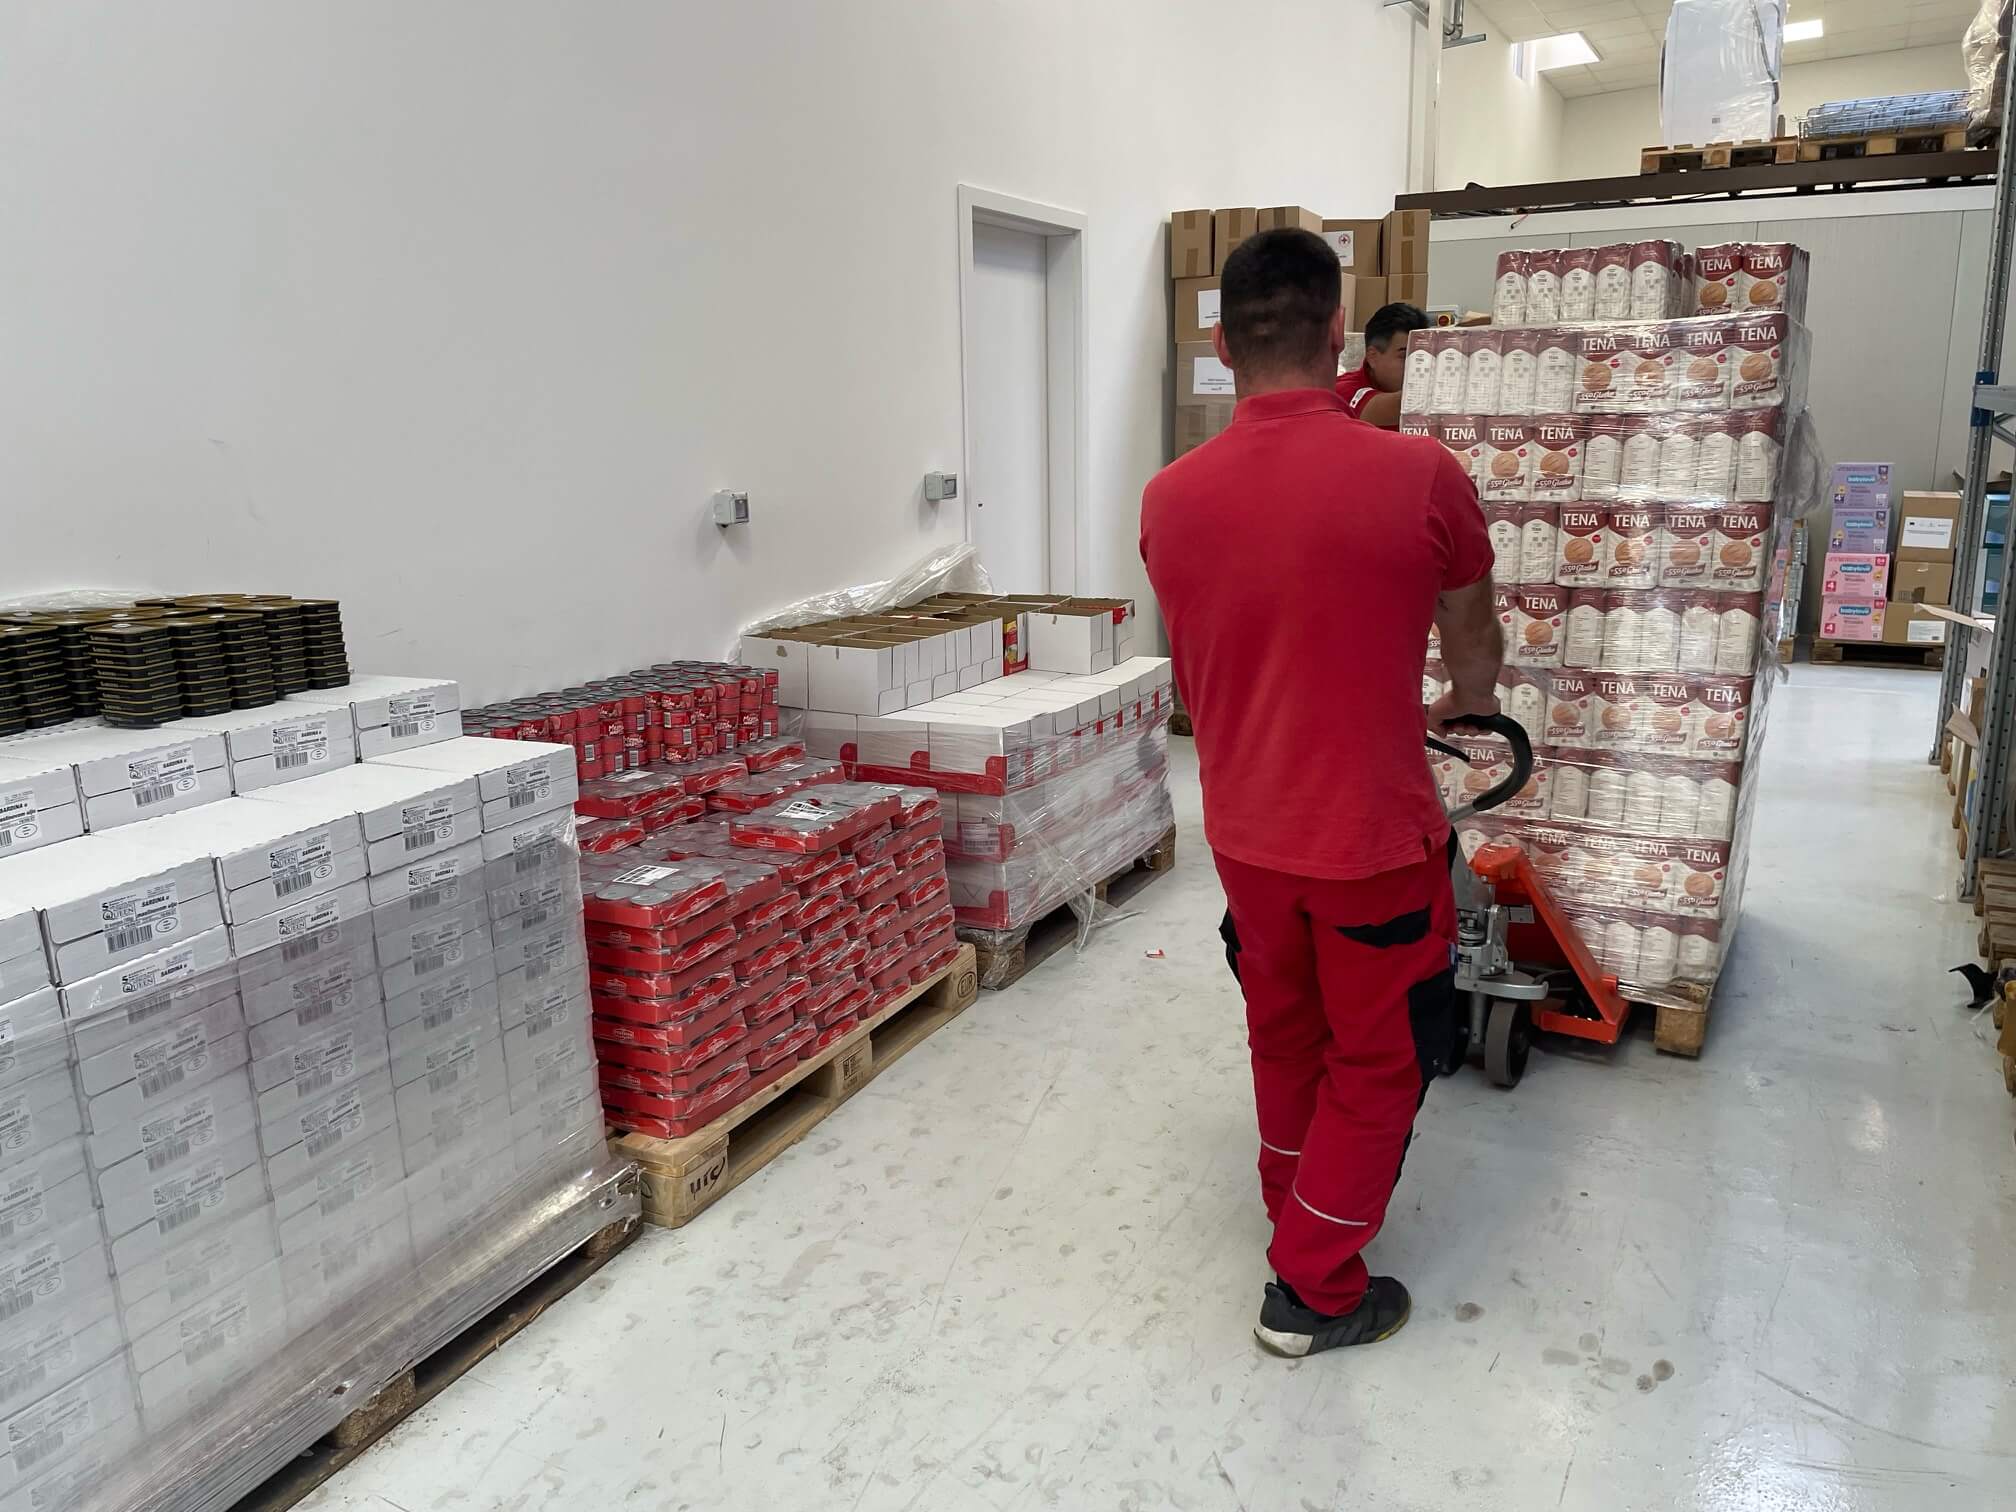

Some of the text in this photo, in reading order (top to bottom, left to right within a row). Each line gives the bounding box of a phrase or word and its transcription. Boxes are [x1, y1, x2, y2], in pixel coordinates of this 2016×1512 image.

[1700, 258, 1733, 271] TENA
[1749, 256, 1783, 269] TENA
[1687, 331, 1723, 345] TENA
[1739, 326, 1777, 341] TENA
[1582, 338, 1617, 351] TENA
[1634, 334, 1670, 348] TENA
[1444, 428, 1477, 440] TENA
[1490, 428, 1524, 440] TENA
[1540, 427, 1575, 441] TENA
[1563, 513, 1598, 526] TENA
[1614, 514, 1650, 527] TENA
[1670, 515, 1706, 528] TENA
[1722, 515, 1759, 529] TENA
[1525, 597, 1558, 610] TENA
[1551, 679, 1585, 692] TENA
[1601, 681, 1635, 694] TENA
[1652, 683, 1688, 699] TENA
[1705, 688, 1742, 703] TENA
[1463, 748, 1495, 761] TENA
[1634, 840, 1668, 856] TENA
[1685, 849, 1721, 863] TENA
